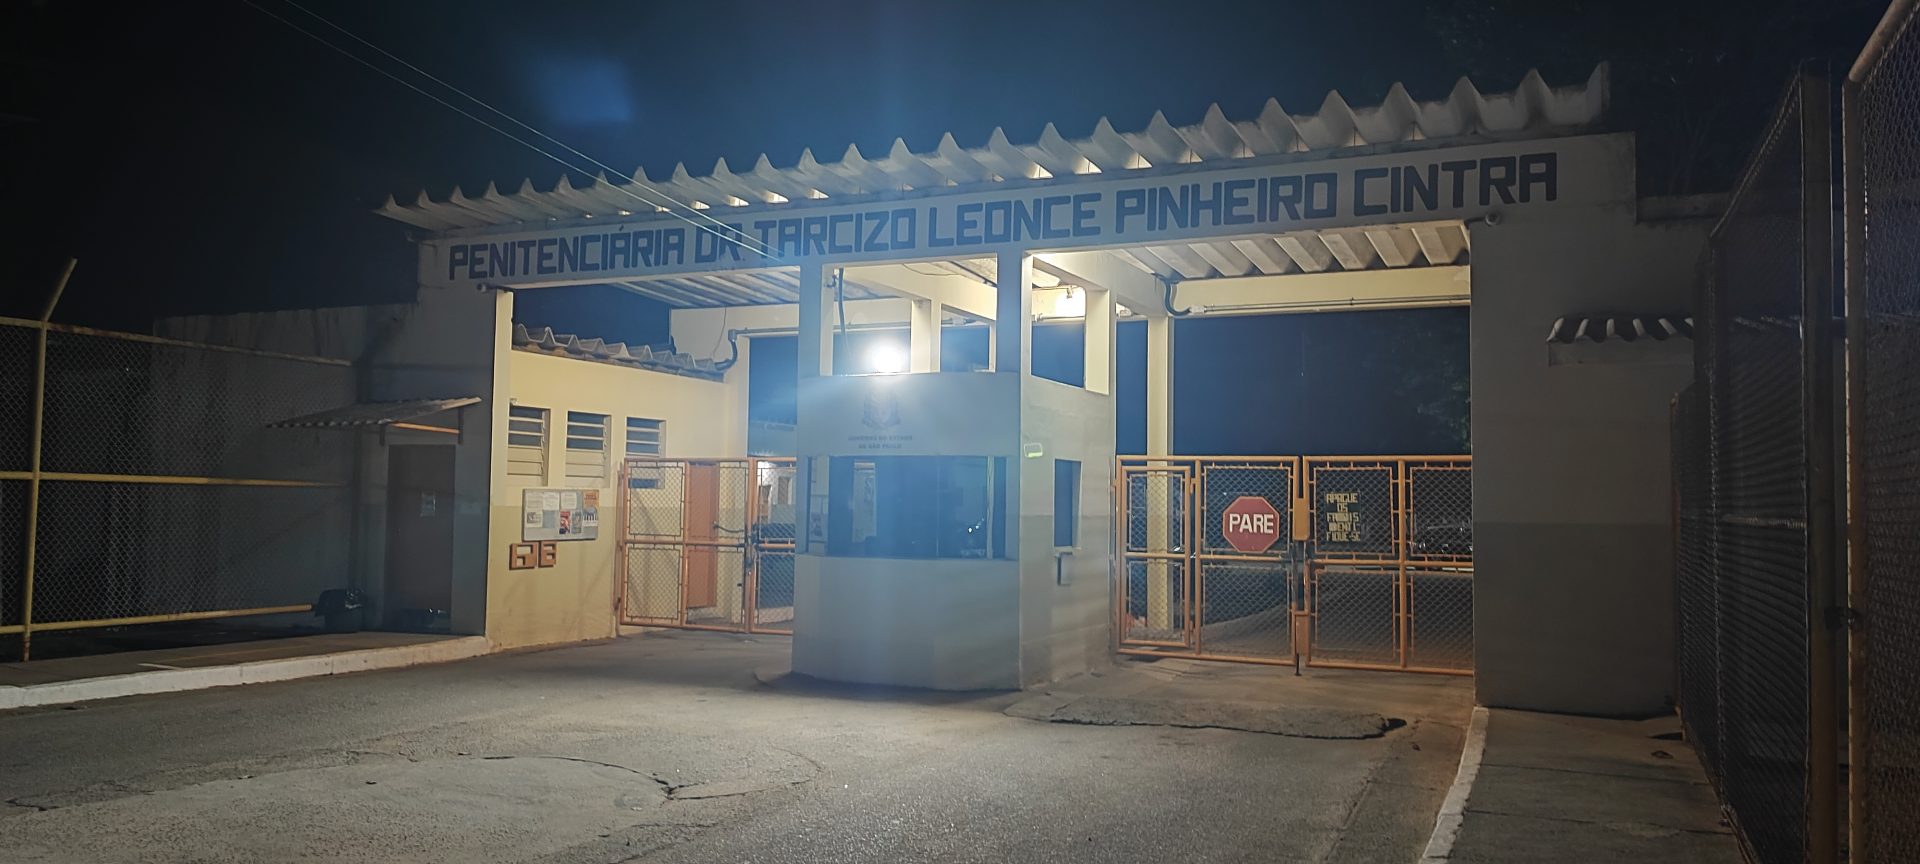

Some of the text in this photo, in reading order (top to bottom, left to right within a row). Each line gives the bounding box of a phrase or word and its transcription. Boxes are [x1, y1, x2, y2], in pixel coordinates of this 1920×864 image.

[449, 224, 685, 281] PENITENCIÁRIA
[754, 207, 917, 259] TARCIZO
[928, 192, 1102, 248] LEONCE
[1115, 172, 1338, 234] PINHEIRO
[1353, 152, 1557, 217] CINTRA
[1229, 513, 1274, 534] PARE
